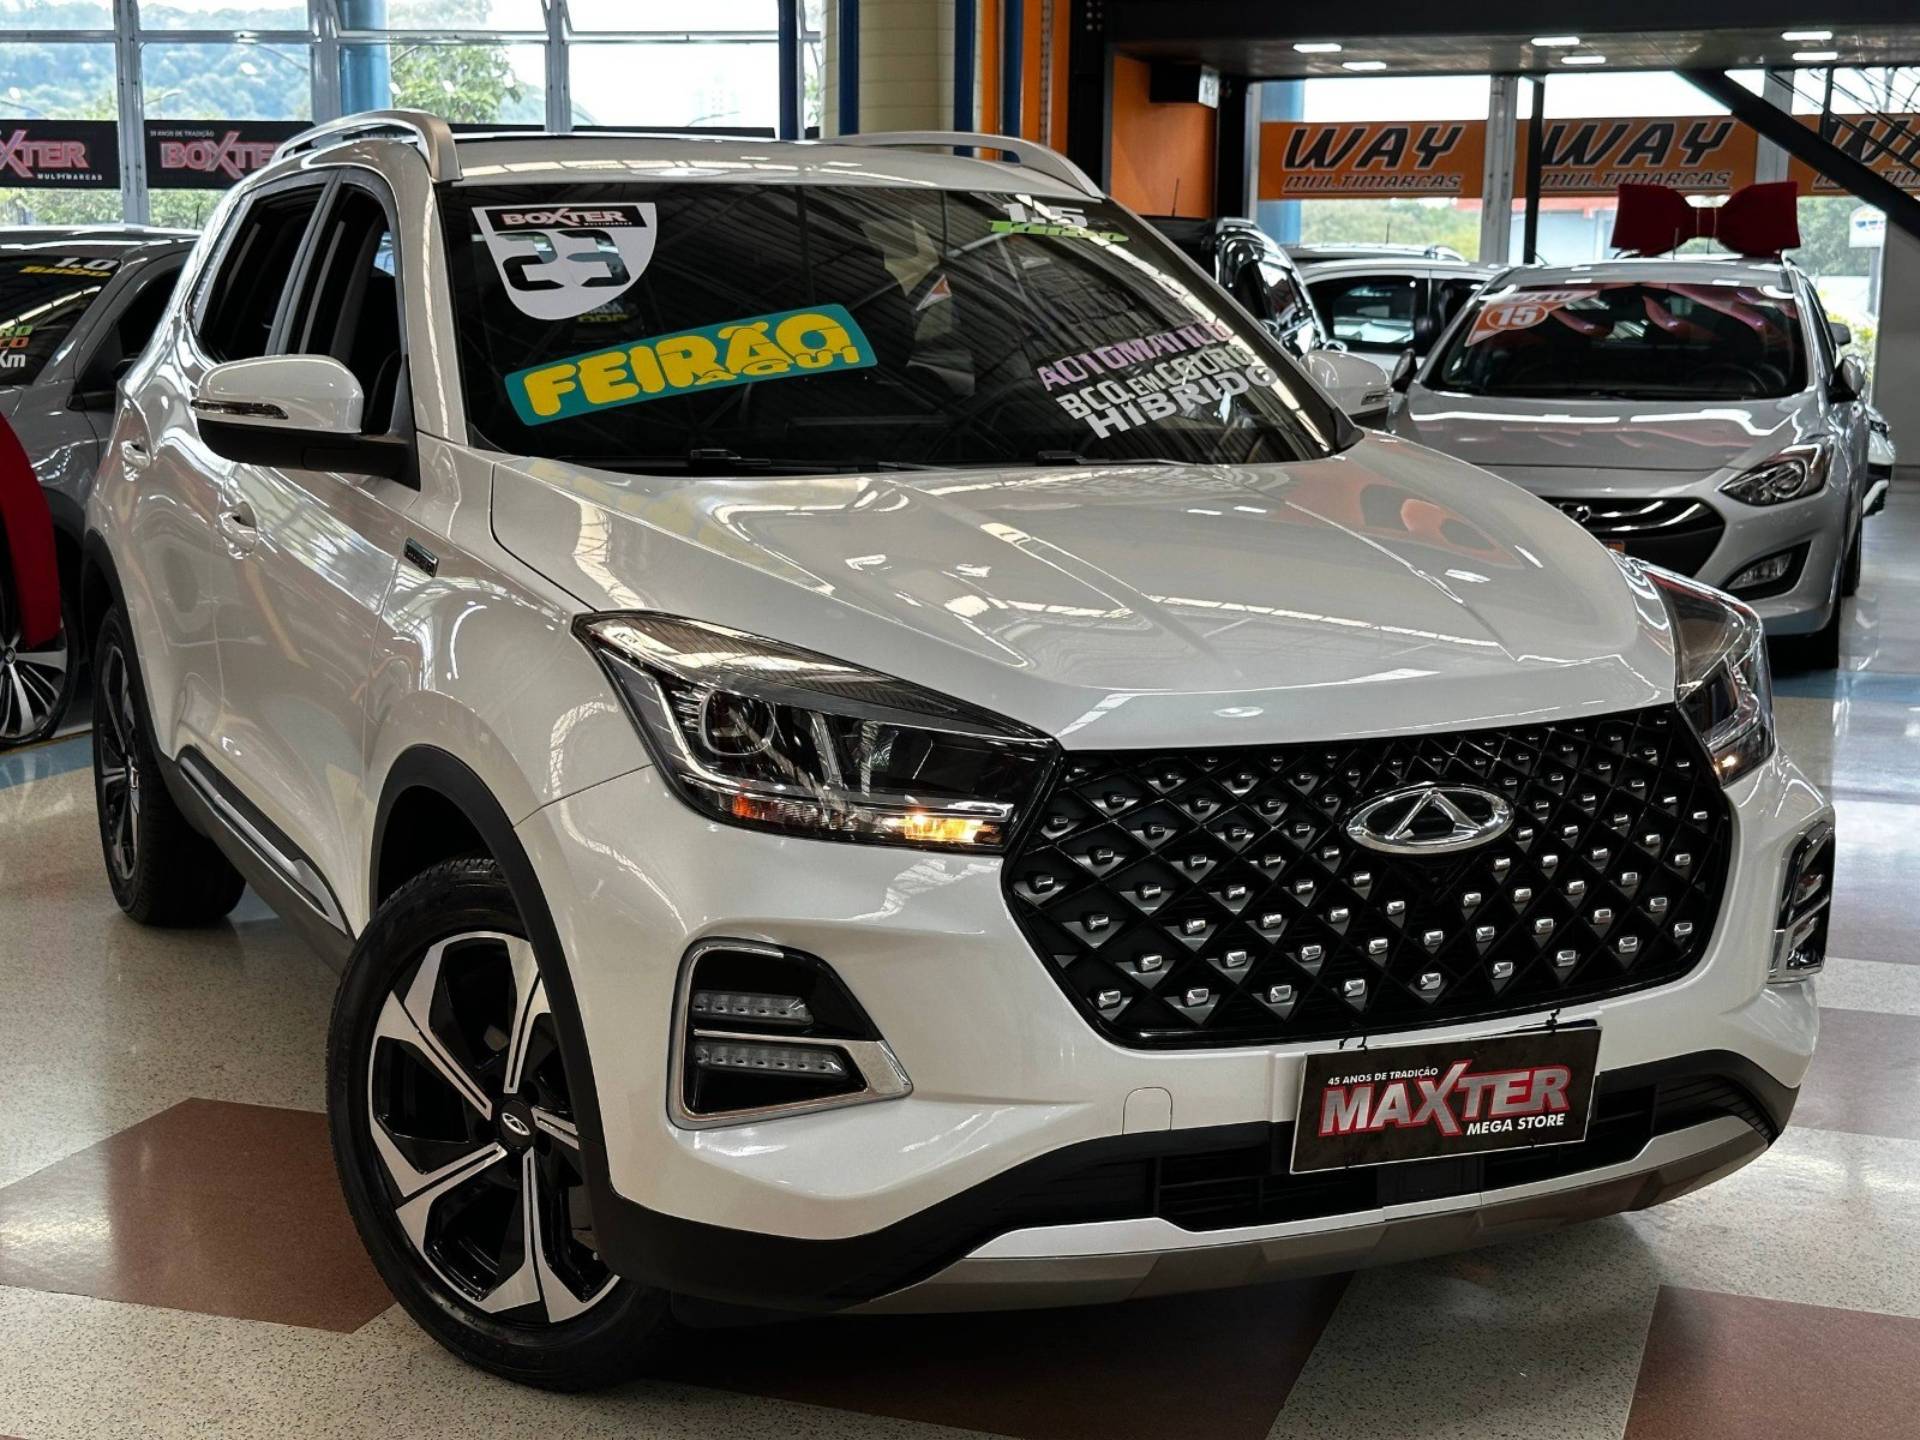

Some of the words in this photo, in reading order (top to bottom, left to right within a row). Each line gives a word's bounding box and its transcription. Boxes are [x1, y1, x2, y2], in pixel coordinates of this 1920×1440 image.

[1284, 126, 1464, 170] WAY
[1541, 120, 1735, 168] WAY
[1283, 174, 1463, 190] MULTIMARCAS
[1541, 170, 1733, 188] MULTIMARCAS
[501, 208, 627, 226] BOXTER
[55, 257, 119, 271] 1.0
[496, 229, 631, 292] 23
[1498, 305, 1538, 326] 15
[524, 314, 852, 417] FEIRÃO
[1126, 372, 1167, 396] EM
[1154, 344, 1255, 385] COURO
[1328, 1077, 1340, 1086] 45
[1342, 1073, 1372, 1085] ANOS
[1374, 1072, 1387, 1081] DE
[1389, 1066, 1439, 1080] TRADIÇÃO
[1320, 1060, 1572, 1135] MAXTER
[1466, 1119, 1513, 1136] MEGA
[1517, 1112, 1566, 1130] STORE
